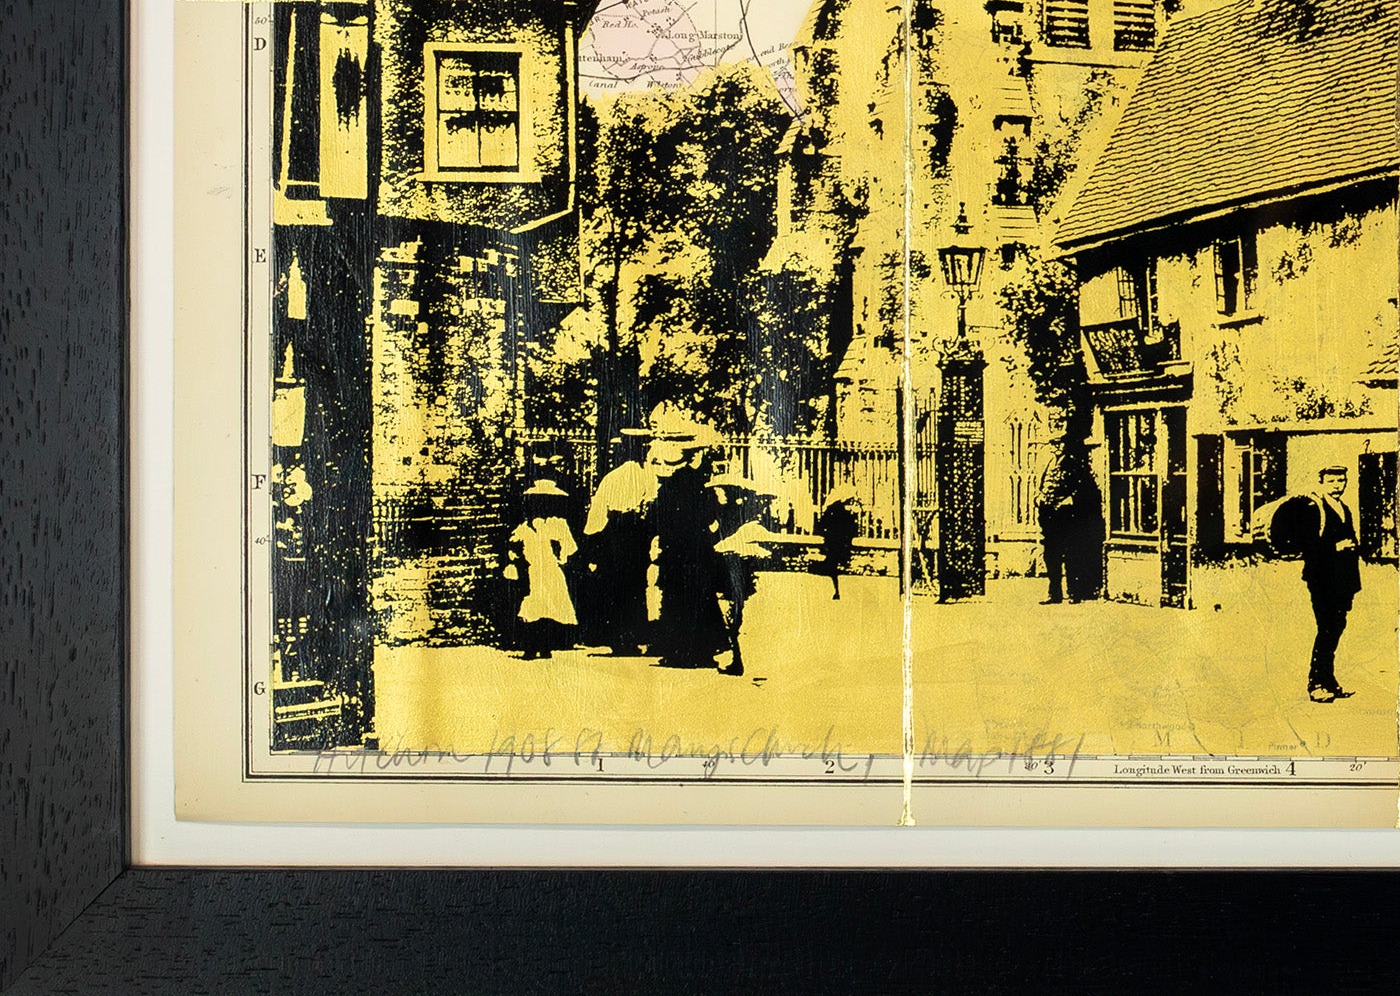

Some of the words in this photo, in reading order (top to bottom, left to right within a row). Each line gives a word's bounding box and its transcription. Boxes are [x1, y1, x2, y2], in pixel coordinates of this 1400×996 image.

[665, 31, 695, 44] Long
[698, 29, 741, 40] Marston
[588, 80, 619, 89] Canal
[1113, 764, 1170, 777] Longitude
[1171, 764, 1197, 775] West
[1199, 764, 1224, 775] from
[1227, 763, 1282, 775] Greenwich
[1285, 763, 1297, 776] 4
